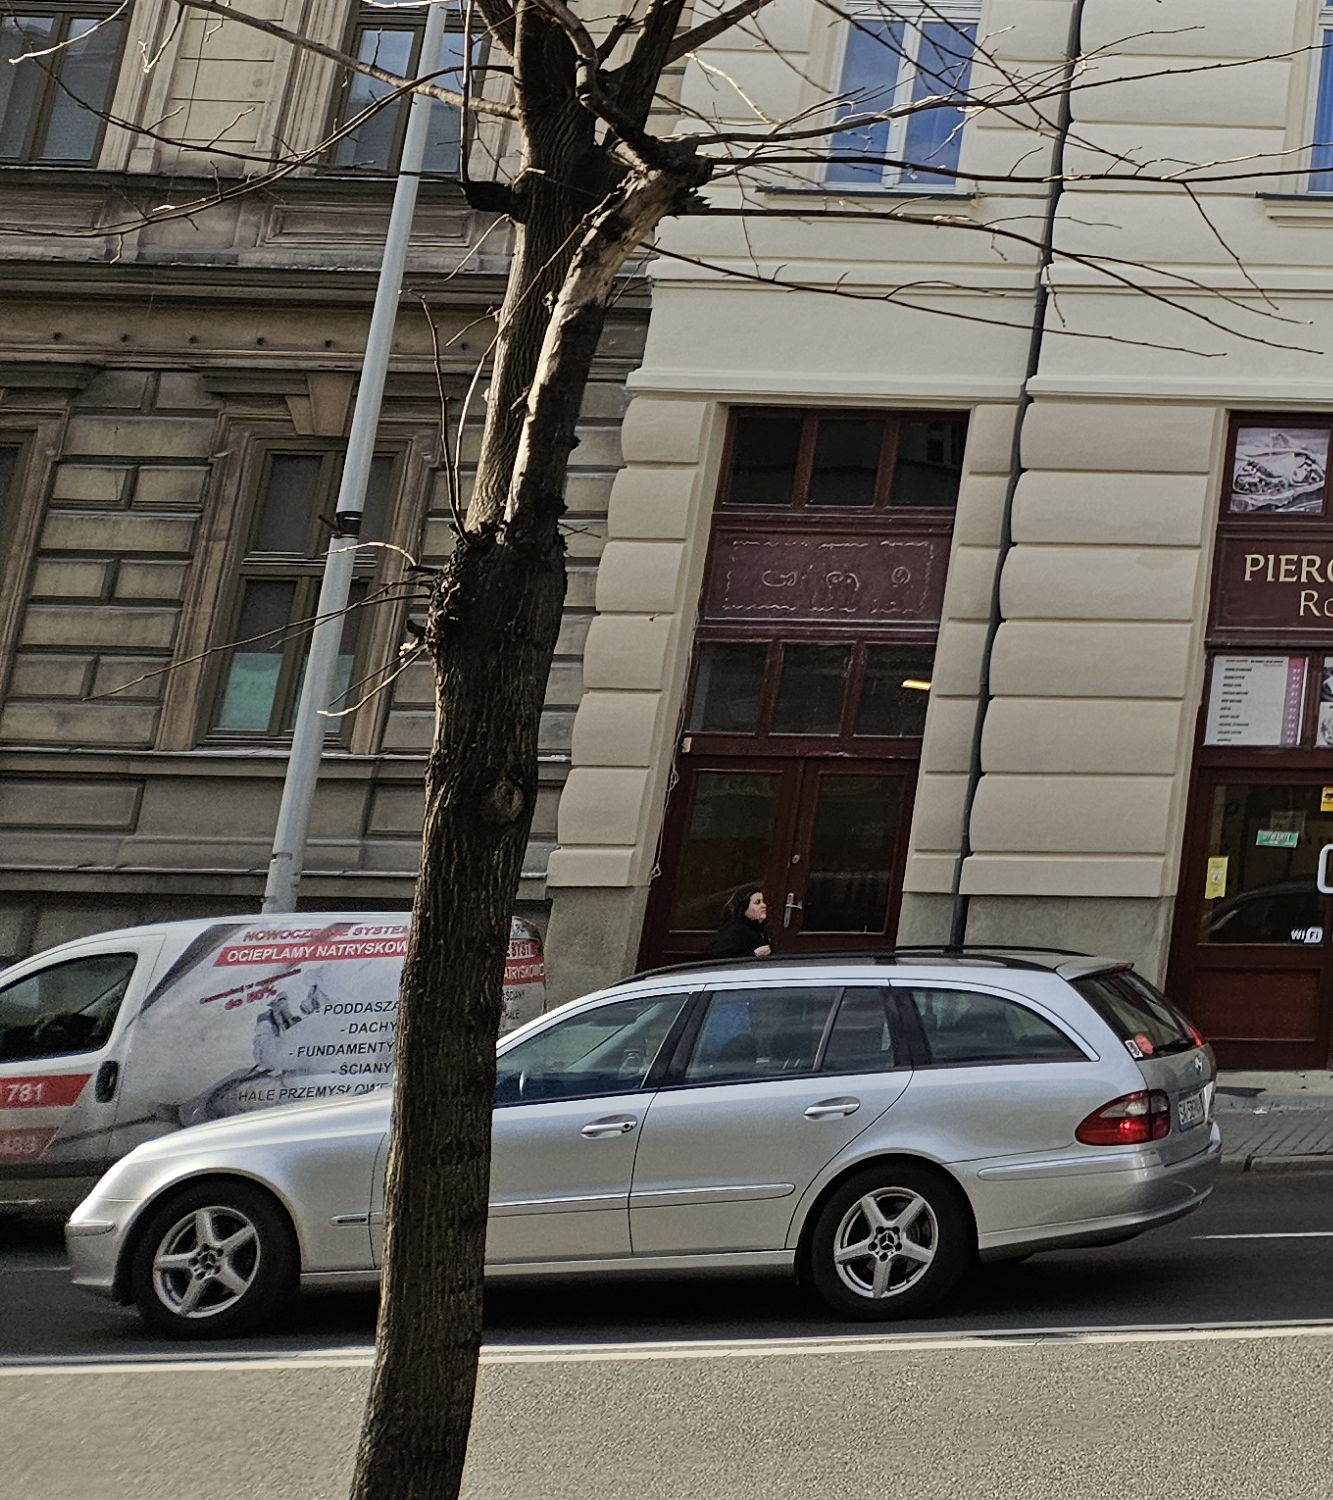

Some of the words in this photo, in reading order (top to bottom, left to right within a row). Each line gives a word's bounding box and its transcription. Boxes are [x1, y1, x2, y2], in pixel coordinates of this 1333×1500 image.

[227, 945, 314, 962] OCIEPLAMY
[348, 1021, 397, 1034] DACHY
[297, 1041, 395, 1057] FUNDAMENTY
[339, 1061, 392, 1075] ŚCIANY
[7, 1082, 44, 1103] 781
[238, 1088, 275, 1102] HALE
